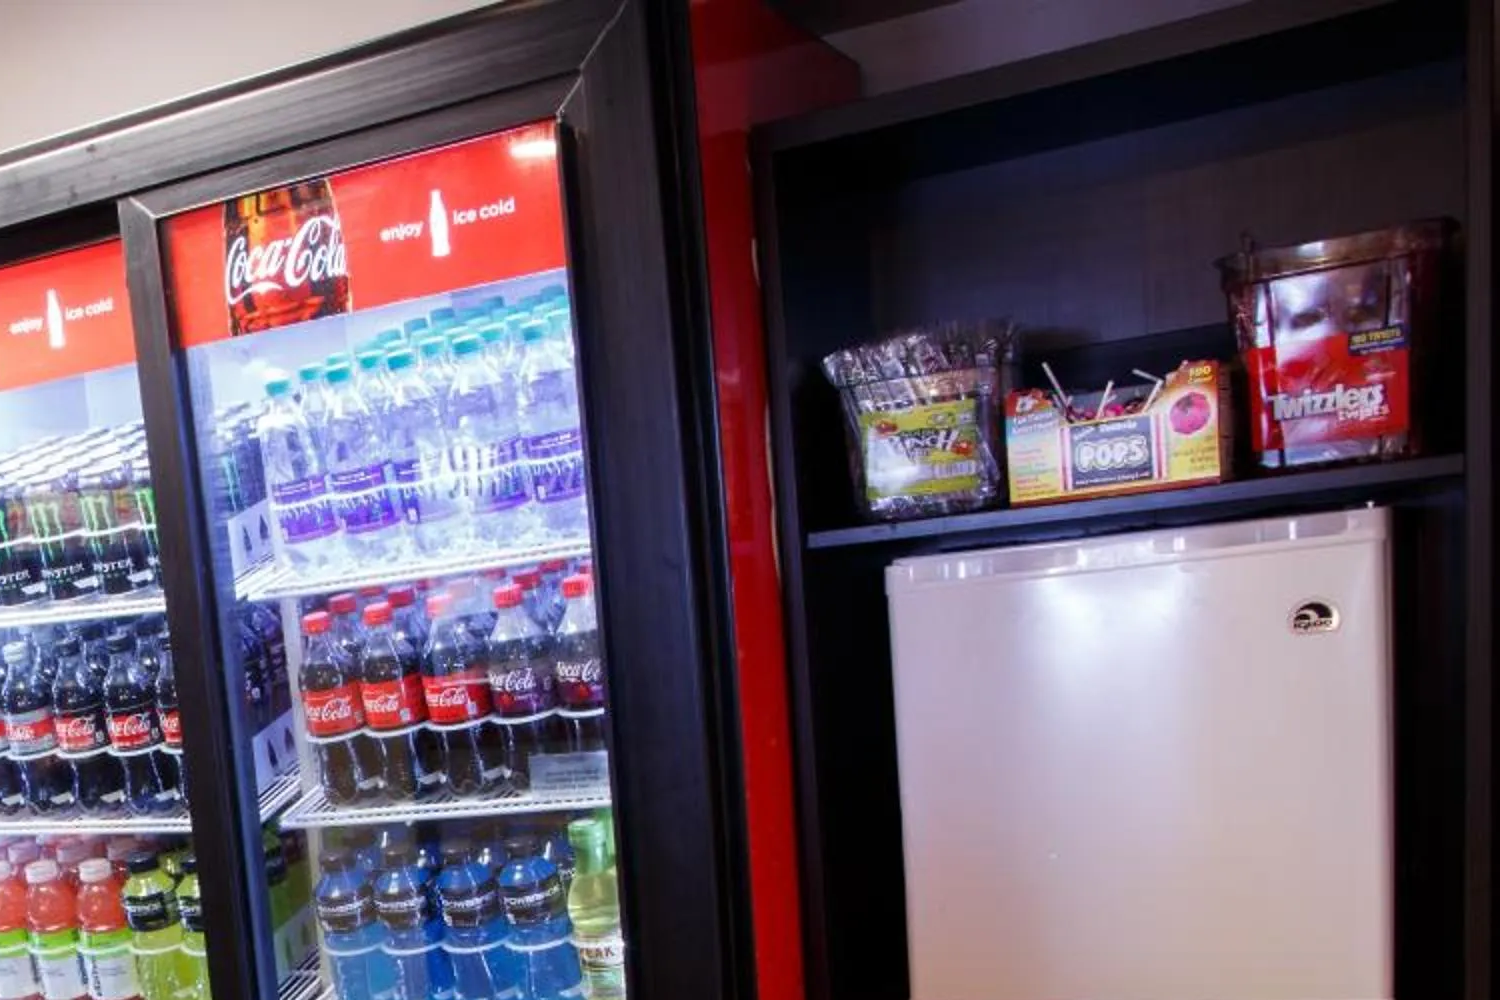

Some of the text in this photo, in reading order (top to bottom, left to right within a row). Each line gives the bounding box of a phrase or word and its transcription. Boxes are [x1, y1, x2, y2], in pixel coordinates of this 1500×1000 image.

[380, 197, 515, 242] enjoy ice cold
[226, 215, 347, 303] Coca-Cola
[9, 298, 113, 335] enjoy ice cold
[1267, 383, 1384, 420] Twizzlers
[1077, 435, 1149, 472] POPS
